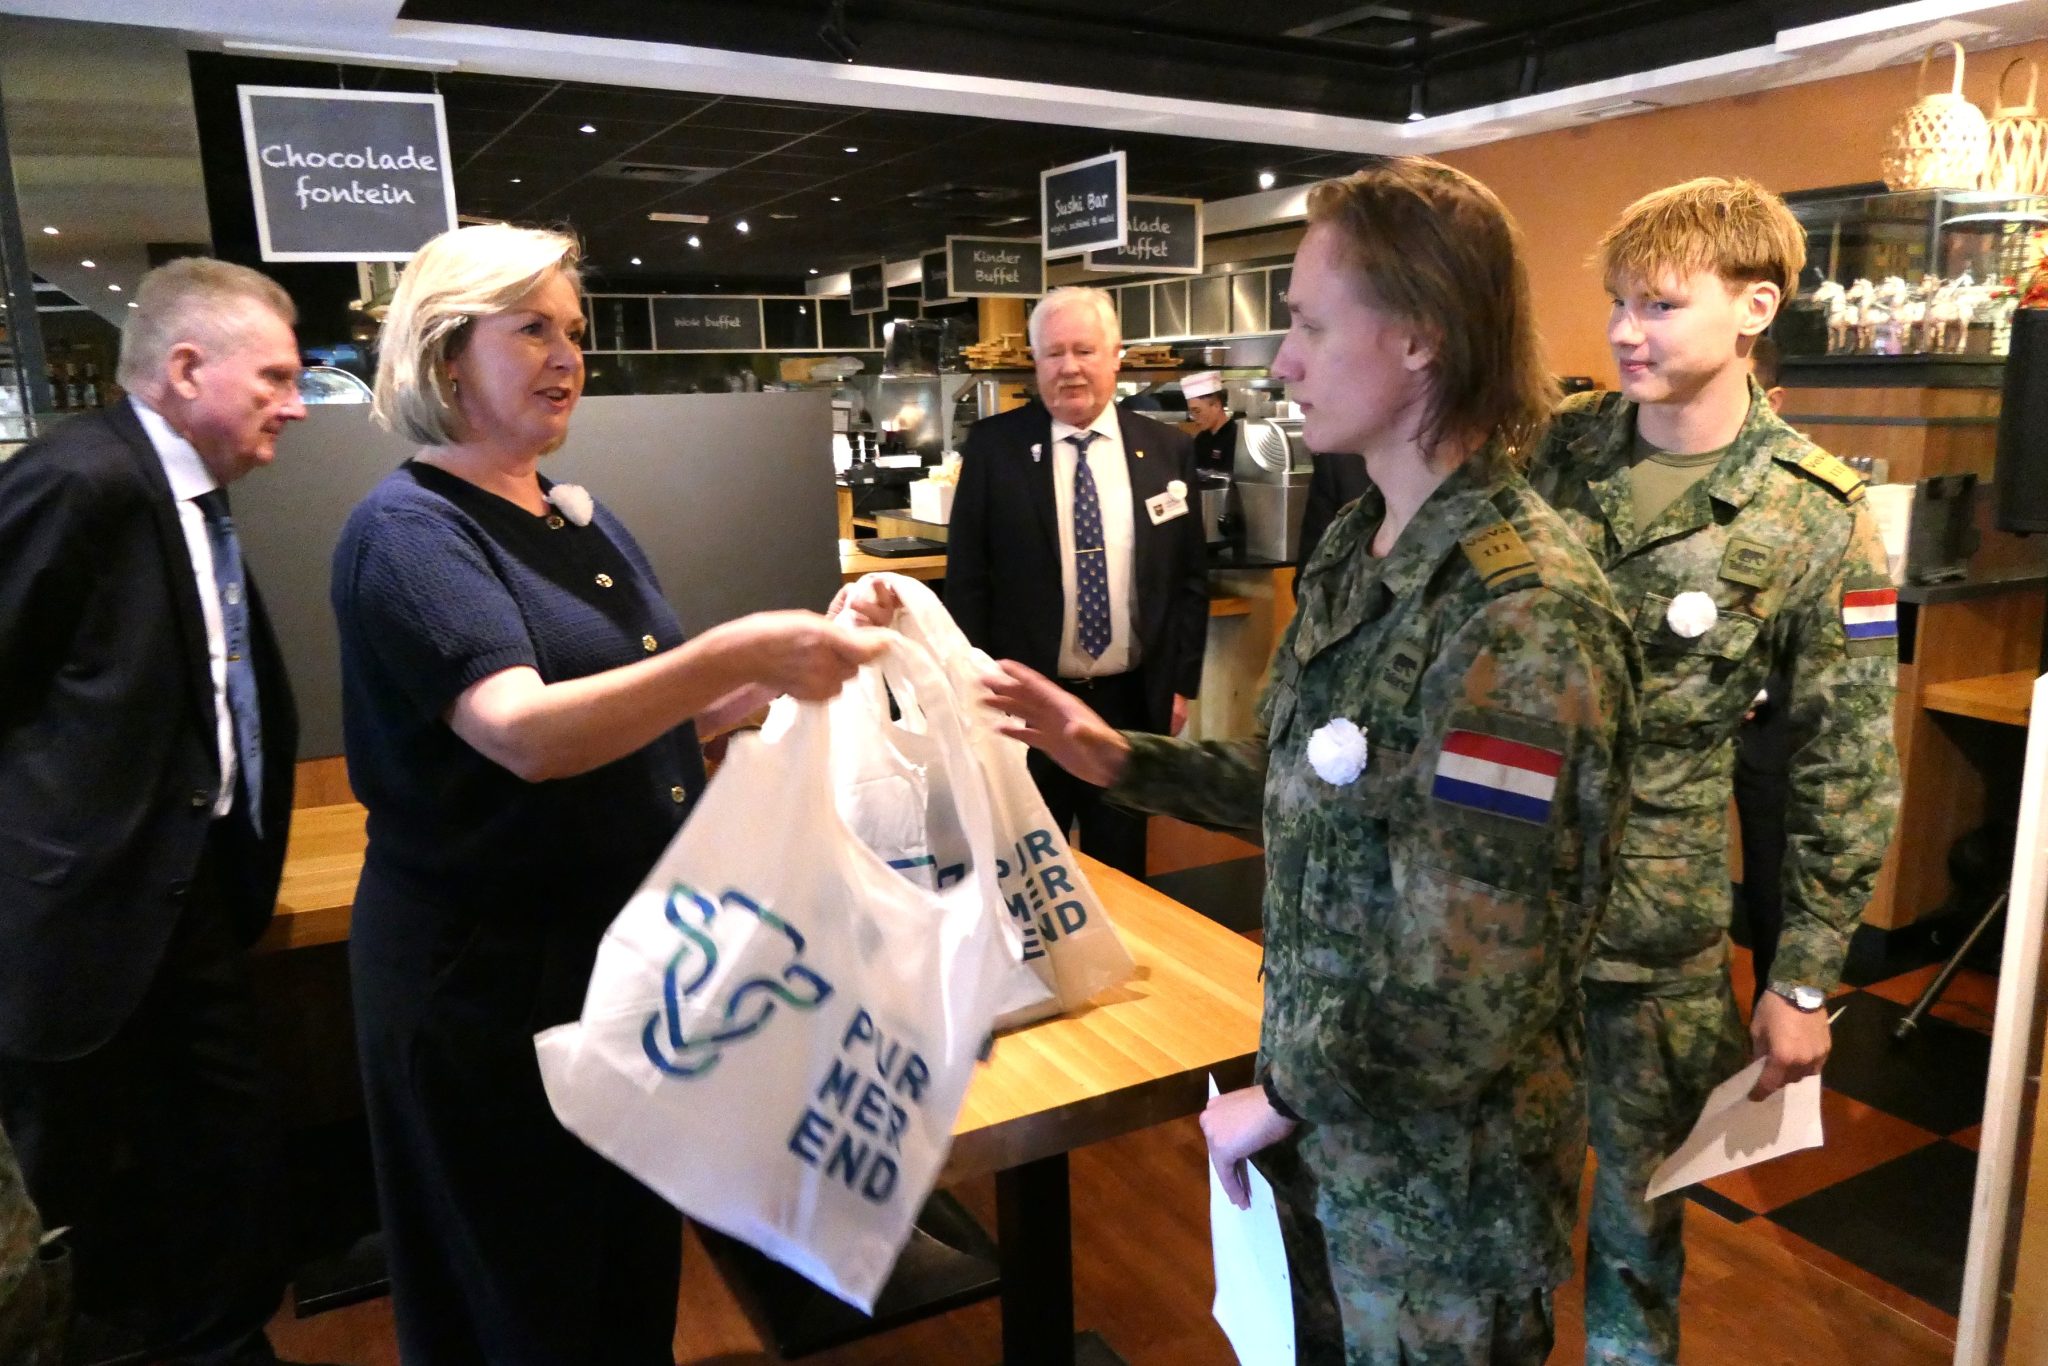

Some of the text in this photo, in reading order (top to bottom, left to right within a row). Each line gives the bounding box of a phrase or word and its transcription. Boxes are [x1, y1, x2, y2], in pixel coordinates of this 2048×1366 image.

[260, 144, 438, 172] Chocolade
[296, 175, 416, 210] fontein
[1055, 193, 1109, 218] Sushi Bar
[973, 250, 1021, 264] Kinder
[975, 267, 1020, 285] Buffet
[1022, 900, 1088, 961] END
[842, 1007, 930, 1103] PUR
[818, 1059, 909, 1155] MER
[788, 1107, 899, 1204] END
